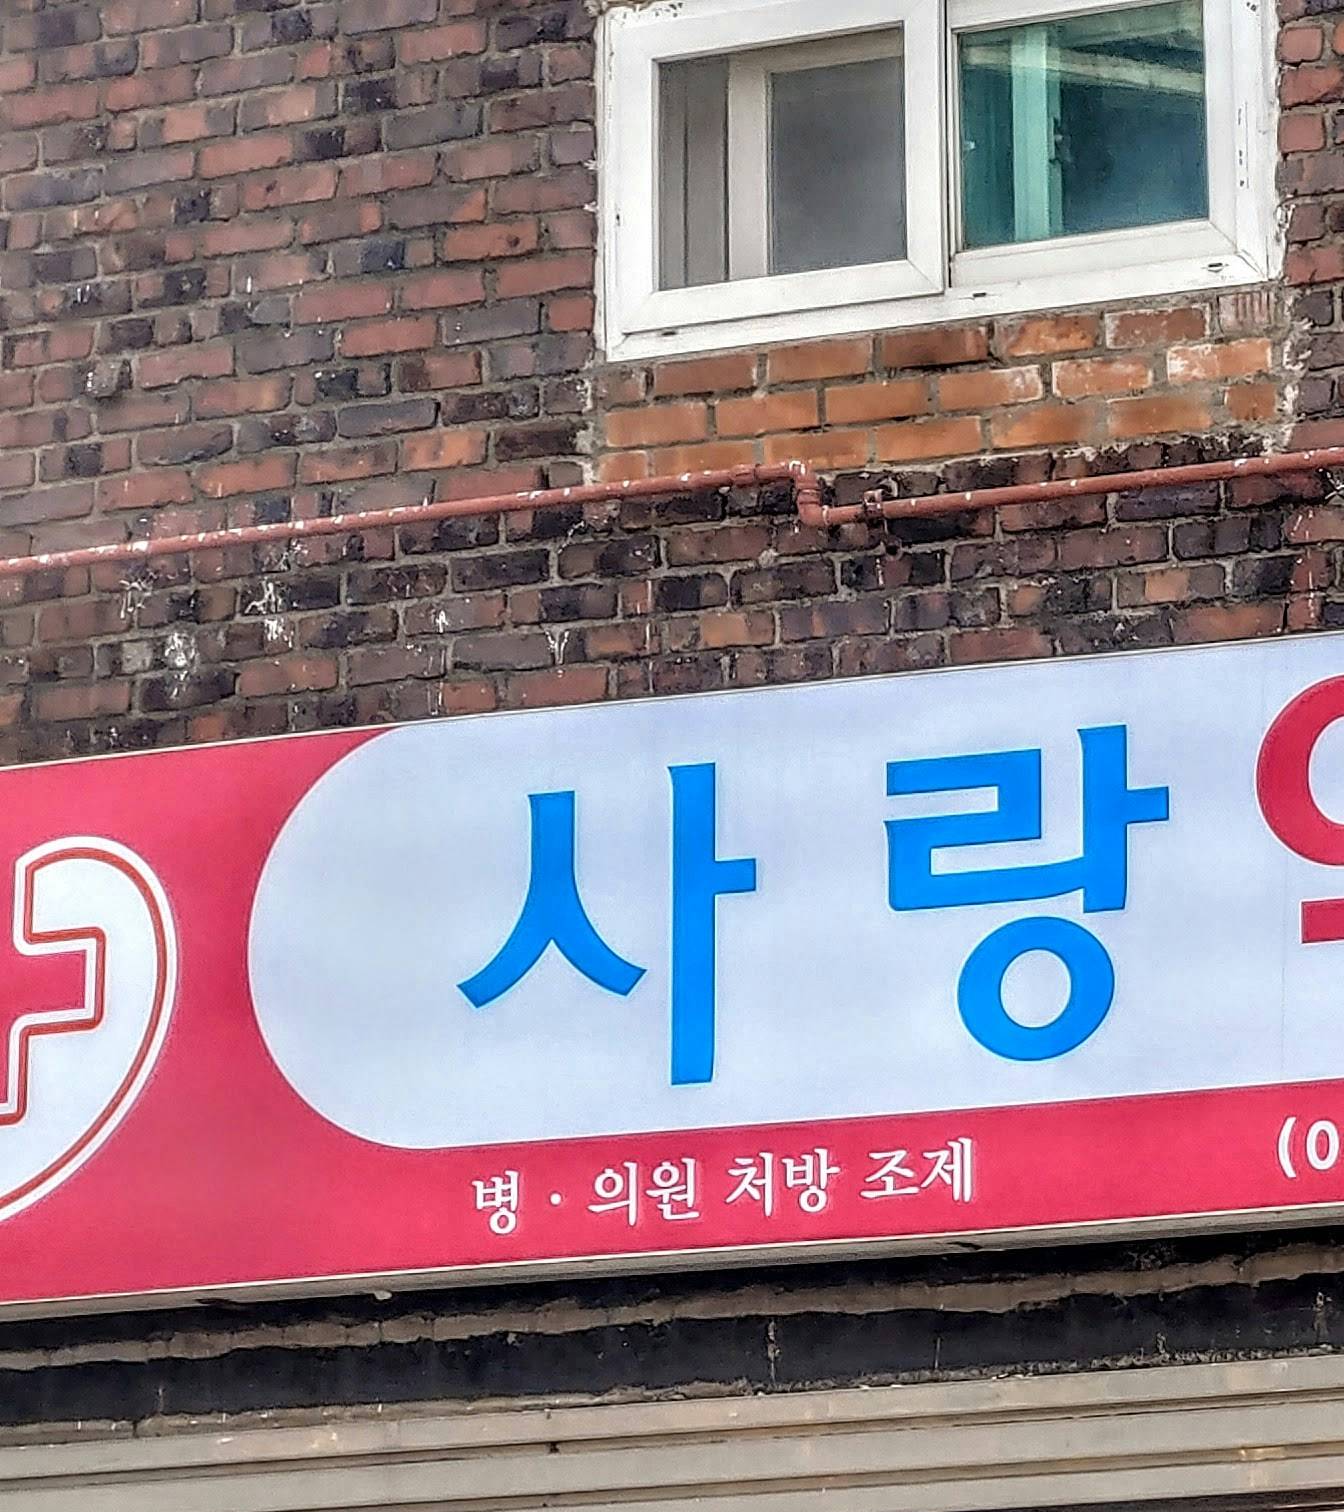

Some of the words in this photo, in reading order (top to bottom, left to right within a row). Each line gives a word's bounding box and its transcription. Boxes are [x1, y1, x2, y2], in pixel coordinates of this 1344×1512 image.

[472, 1168, 522, 1233] 병
[592, 1157, 699, 1223] 의원
[726, 1148, 839, 1214] 처방
[860, 1136, 975, 1203] 조제
